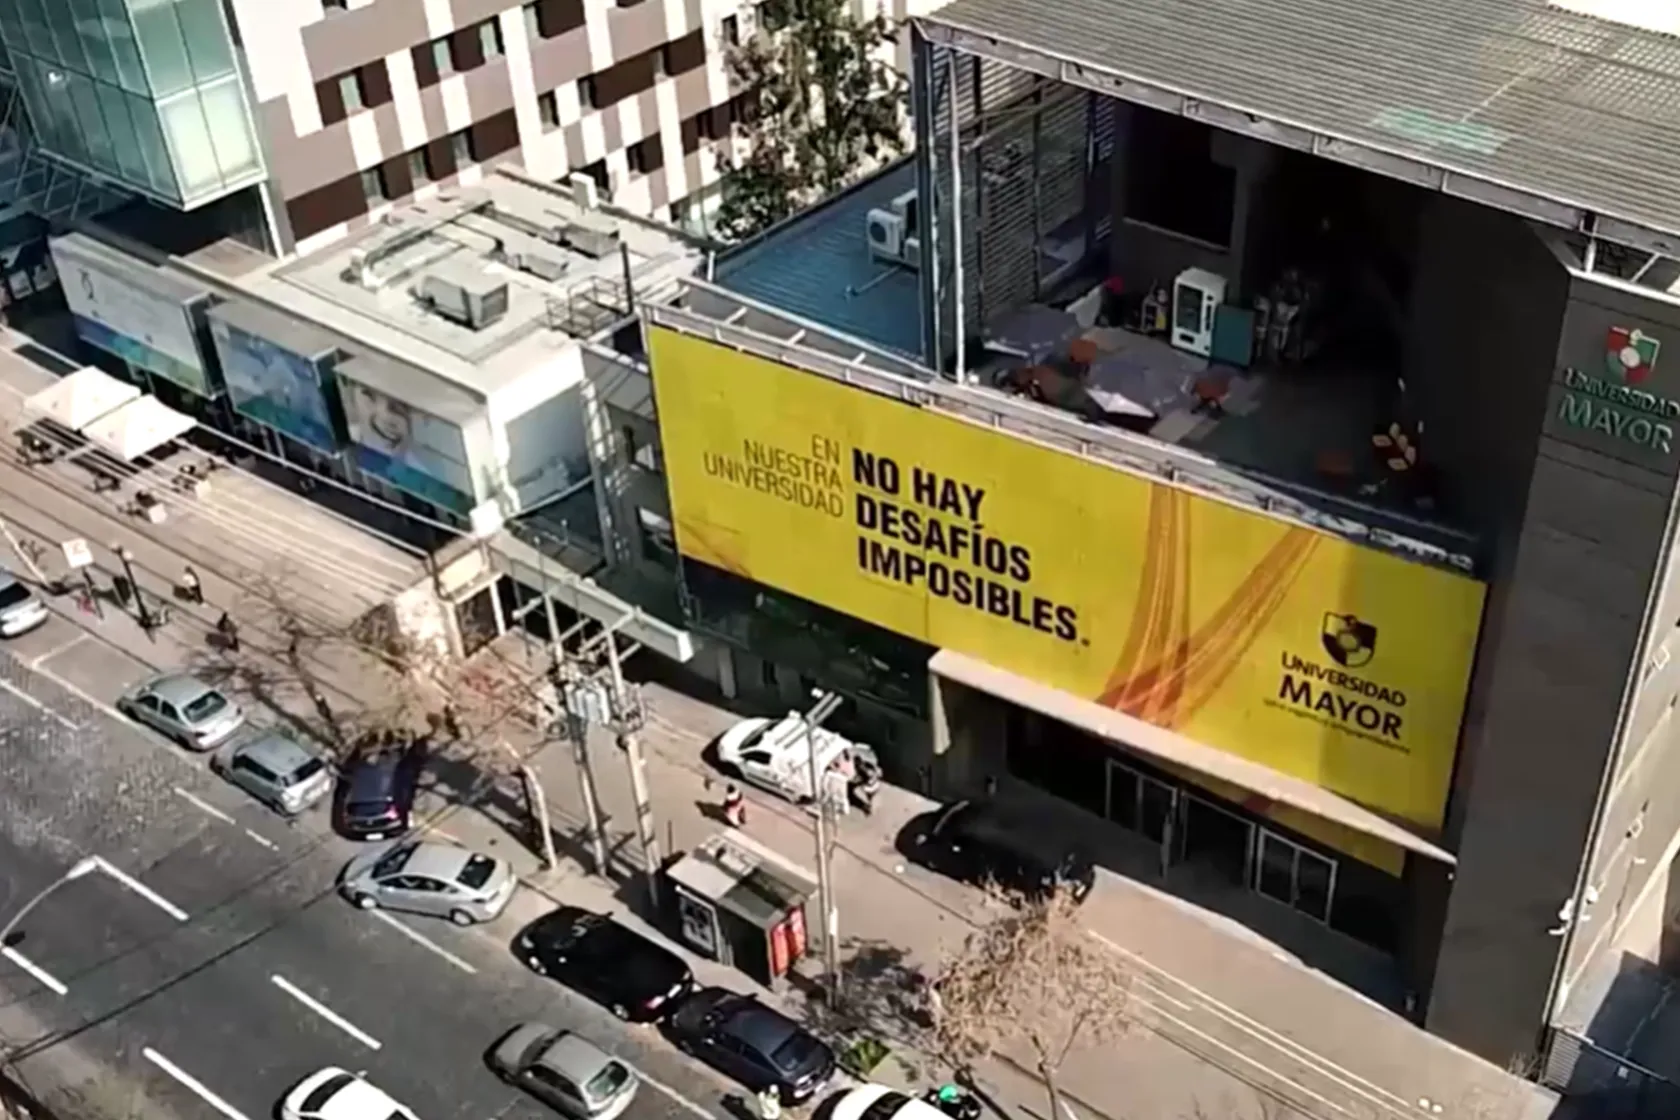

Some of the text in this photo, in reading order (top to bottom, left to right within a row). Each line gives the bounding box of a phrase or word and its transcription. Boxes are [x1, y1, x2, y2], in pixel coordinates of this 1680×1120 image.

[1559, 393, 1673, 454] MAYOR
[1565, 367, 1680, 417] UNIVERSIDAD
[743, 439, 843, 490] NUESTRA
[811, 433, 841, 465] EN
[703, 453, 844, 518] UNIVERSIDAD
[852, 447, 986, 522] NO HAY
[856, 494, 1031, 583] DESAFÍOS
[858, 537, 1091, 646] IMPOSIBLES.
[1279, 674, 1403, 740] MAYOR
[1281, 651, 1407, 708] UNIVERSIDAD
